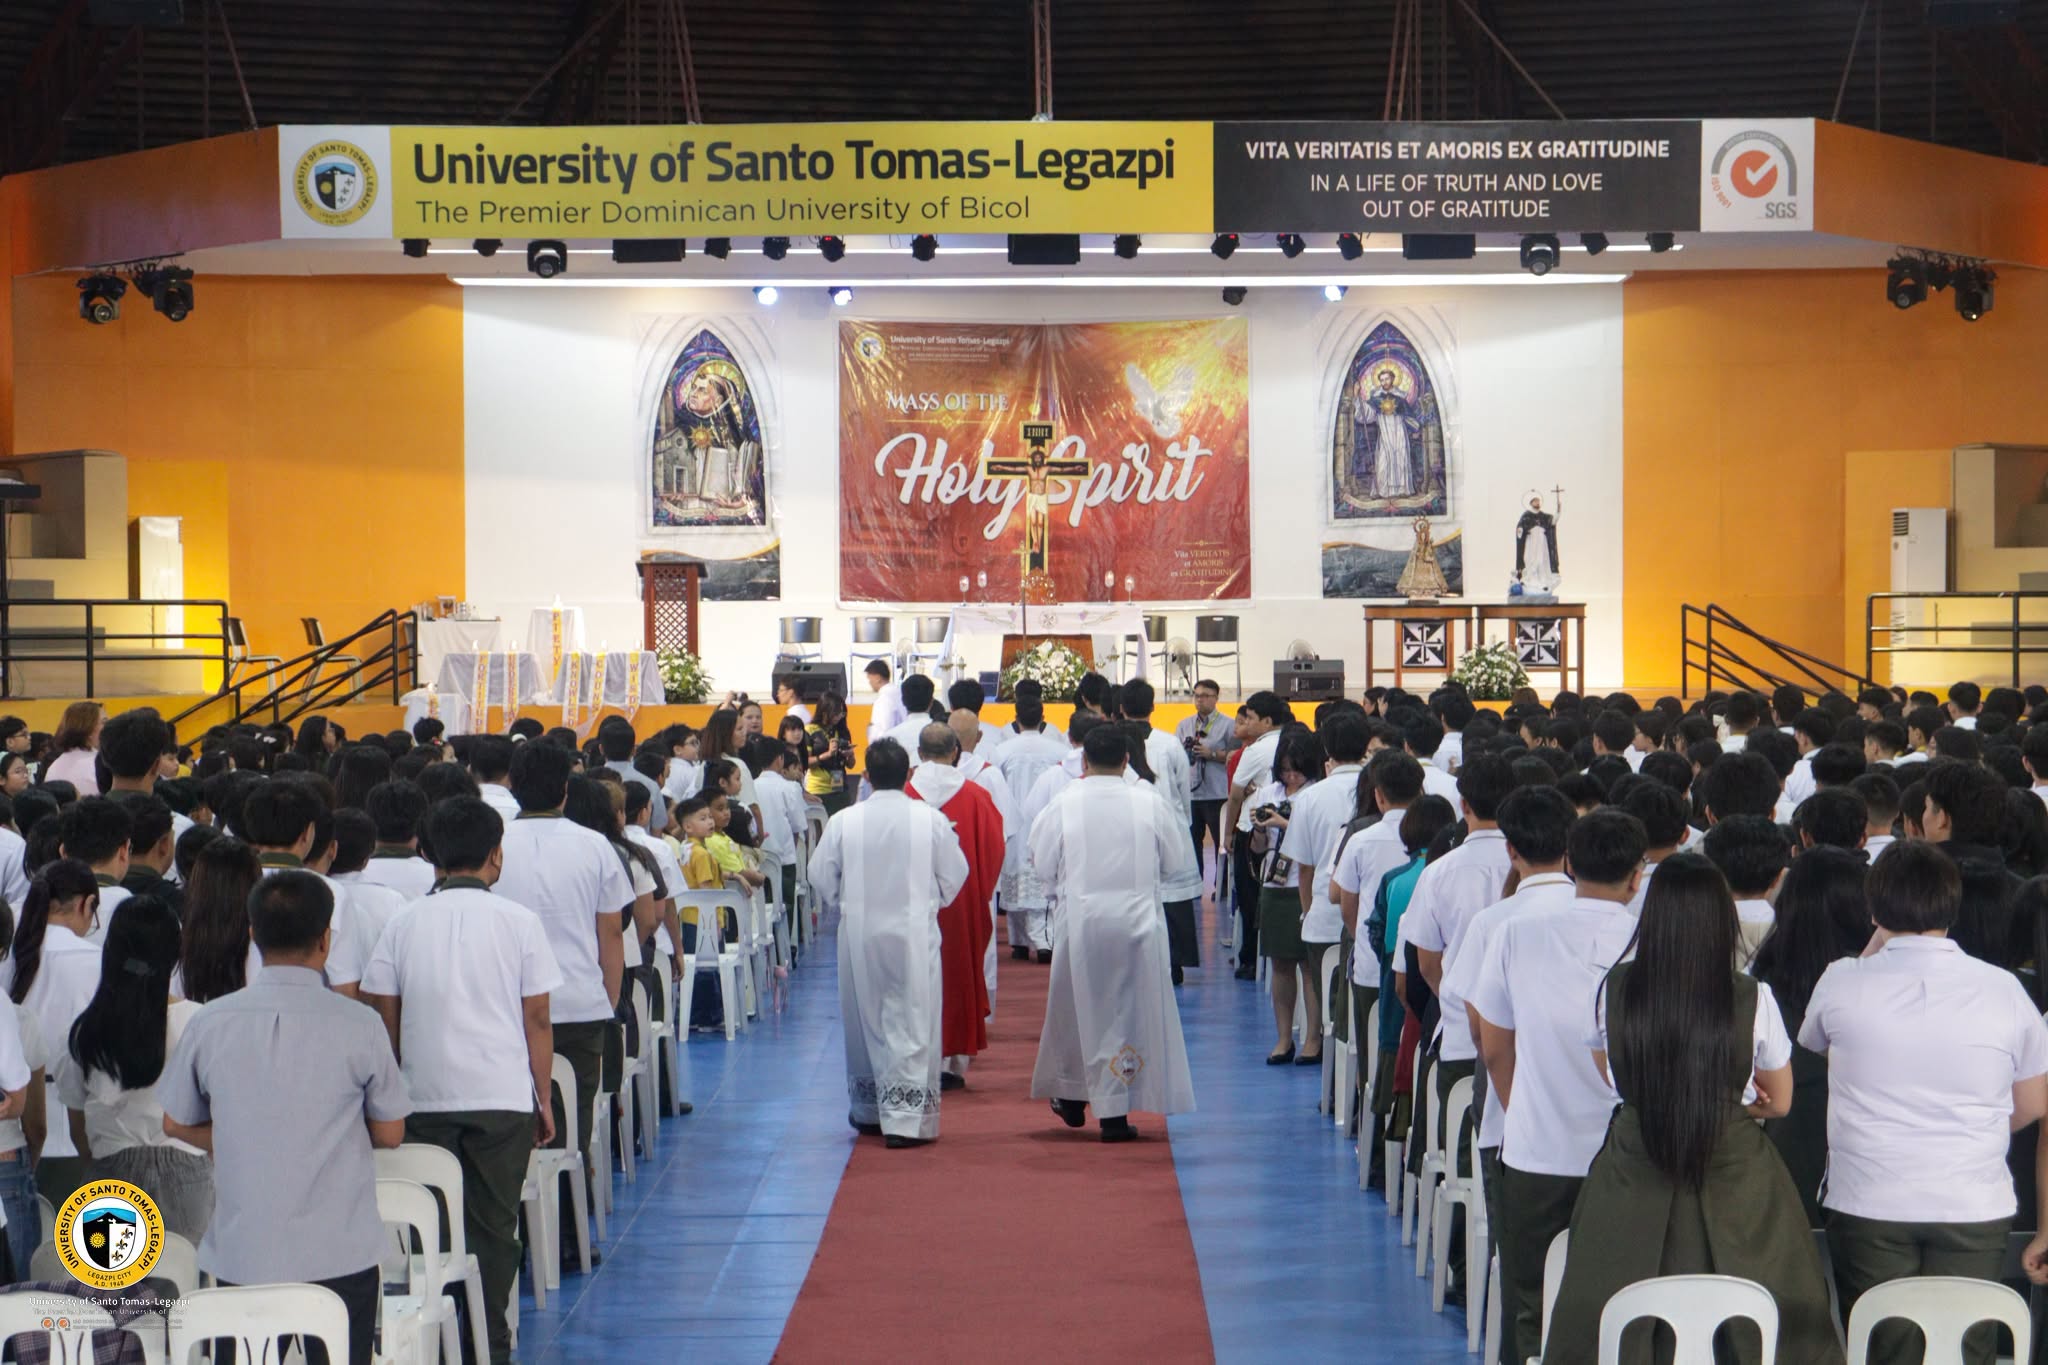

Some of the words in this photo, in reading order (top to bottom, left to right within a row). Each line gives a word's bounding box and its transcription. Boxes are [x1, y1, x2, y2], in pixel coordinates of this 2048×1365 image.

[320, 145, 347, 153] SANTO
[1246, 142, 1290, 160] VITA
[1294, 142, 1393, 160] VERITATIS
[1398, 142, 1422, 159] ET
[1425, 141, 1503, 159] AMORIS
[1508, 141, 1533, 159] EX
[1538, 140, 1670, 159] GRATITUDINE
[414, 143, 637, 194] University
[650, 141, 694, 183] of
[707, 141, 834, 183] Santo
[845, 138, 1174, 190] Tomas-Legazpi
[1311, 174, 1330, 192] IN
[1335, 174, 1350, 192] A
[1356, 174, 1396, 192] LIFE
[1402, 174, 1428, 192] OF
[1434, 174, 1498, 192] TRUTH
[1504, 173, 1547, 192] AND
[1553, 173, 1603, 191] LOVE
[416, 201, 468, 223] The
[481, 201, 591, 224] Premier
[604, 200, 754, 223] Dominican
[767, 197, 909, 223] University
[922, 197, 950, 219] of
[961, 196, 1029, 219] Bicol
[1362, 200, 1401, 218] OUT
[1409, 200, 1436, 218] OF
[1442, 199, 1550, 218] GRATITUDE
[1765, 201, 1797, 218] SGS
[890, 335, 926, 345] University
[927, 335, 935, 344] of
[936, 336, 957, 344] Santo
[886, 390, 940, 414] MASS
[945, 392, 971, 411] OF
[874, 431, 1027, 541] Holy
[1046, 434, 1213, 527] Spirit
[552, 612, 561, 666] PIETY
